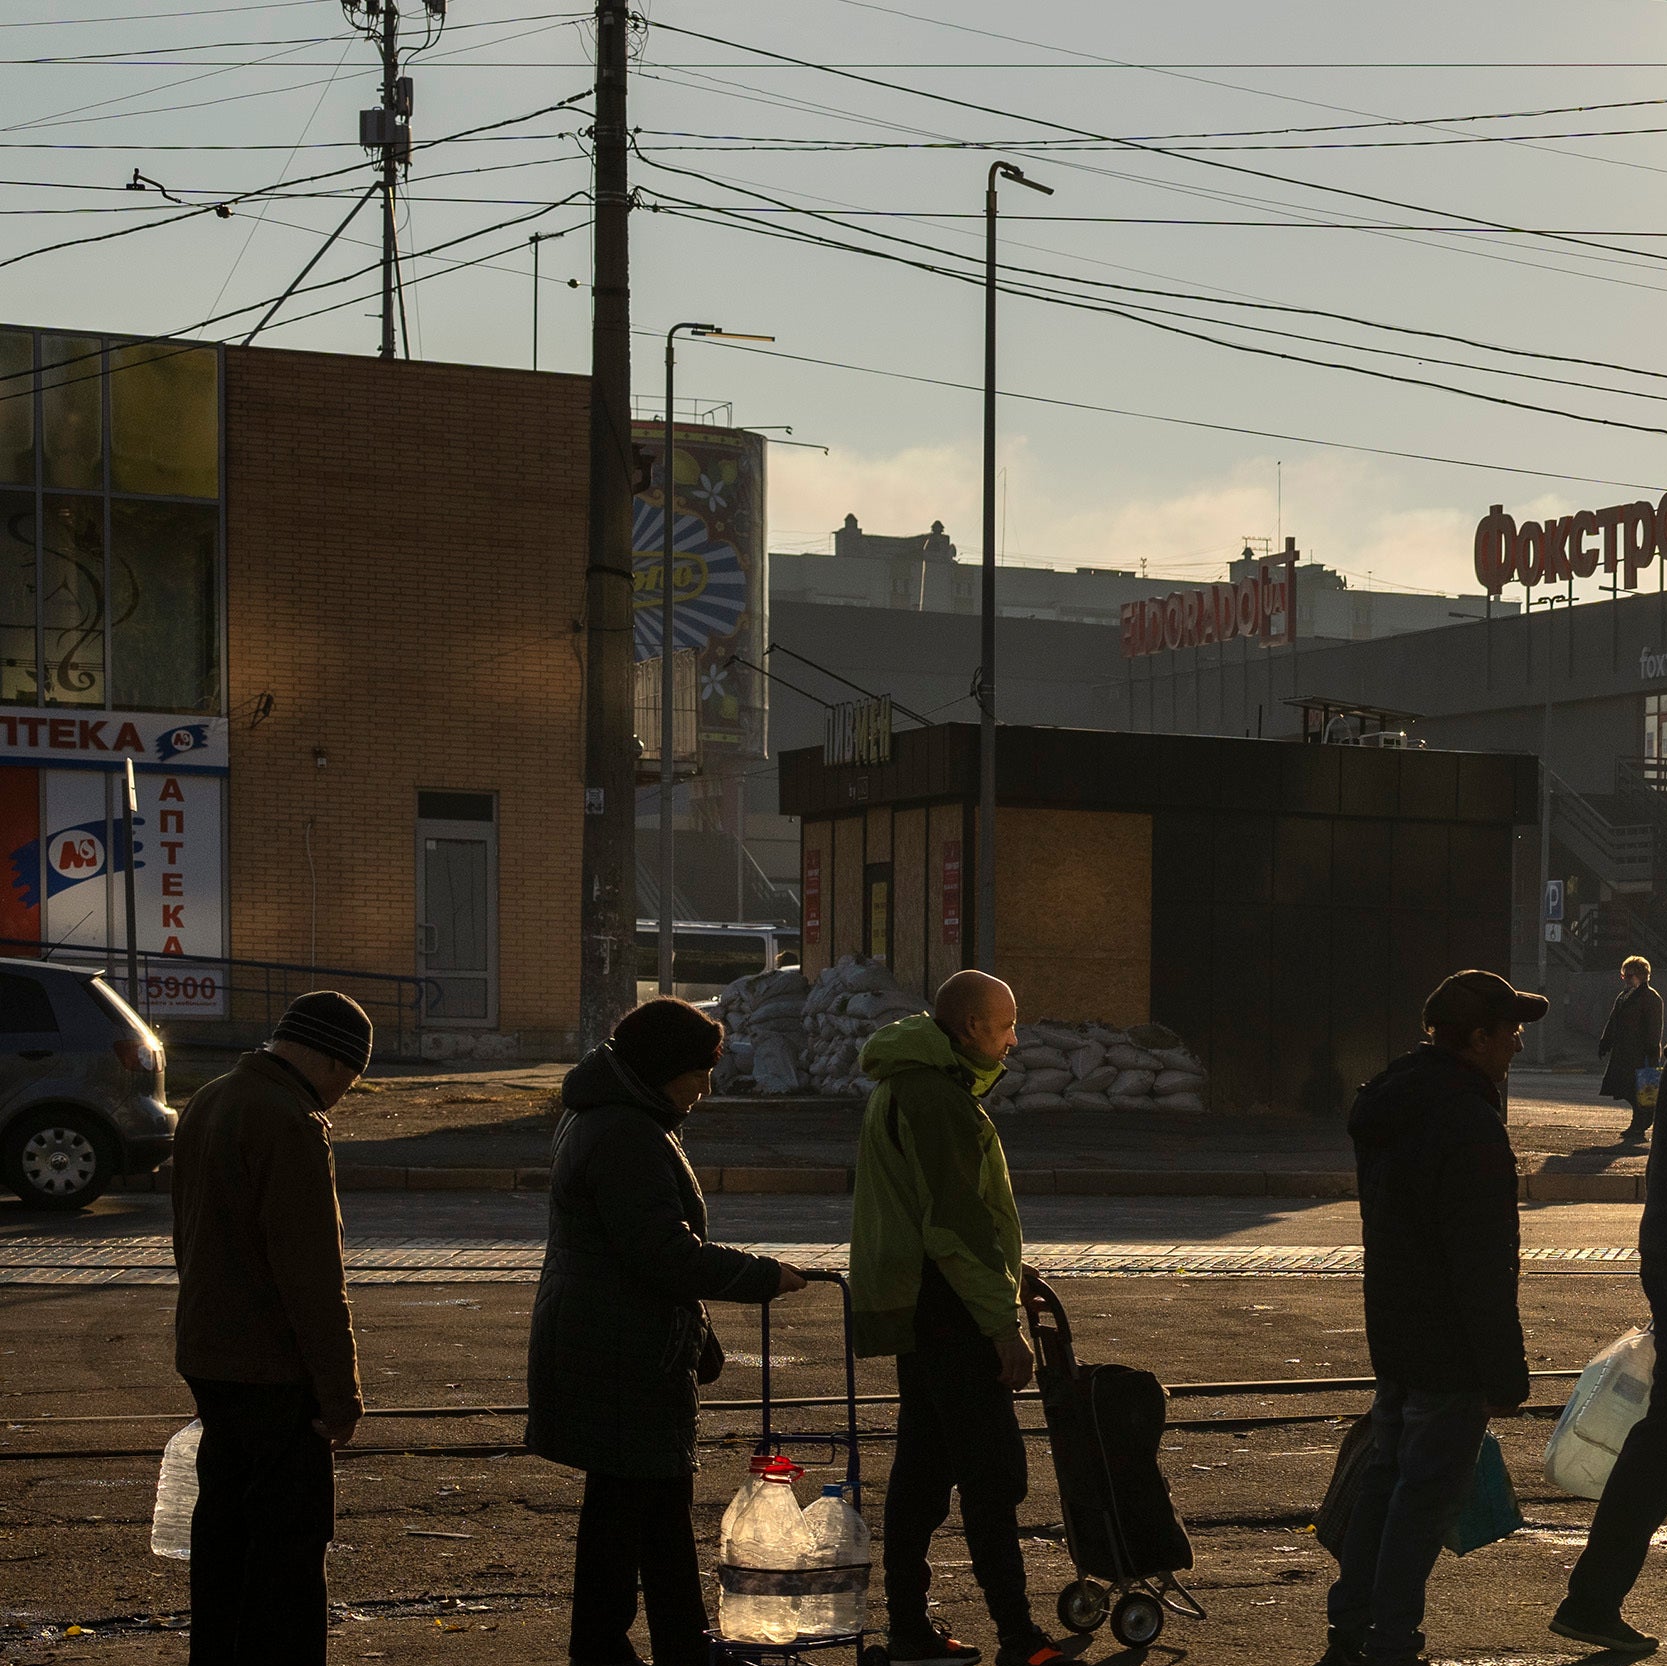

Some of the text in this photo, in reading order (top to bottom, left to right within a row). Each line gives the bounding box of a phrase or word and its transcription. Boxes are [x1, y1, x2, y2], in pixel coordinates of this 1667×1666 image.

[1120, 577, 1259, 658] ELDORADO
[158, 777, 186, 956] АПТЕКА
[147, 975, 216, 1000] 5900
